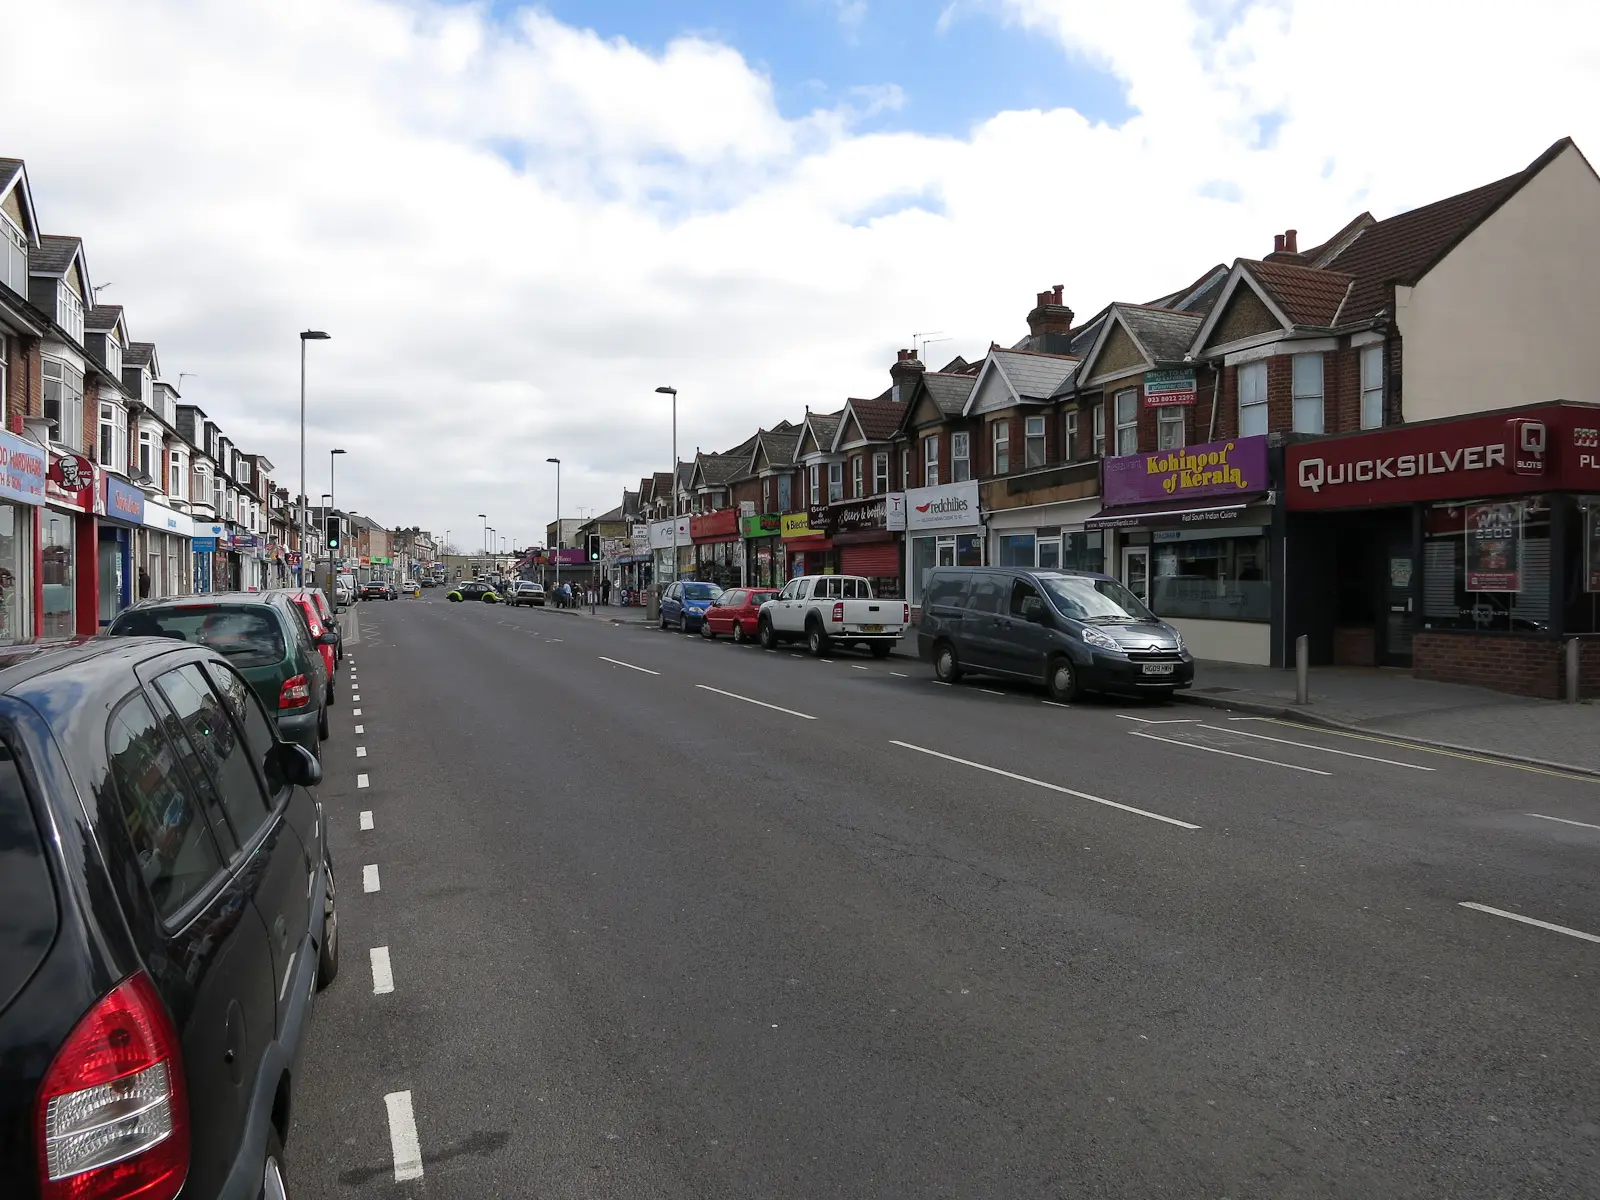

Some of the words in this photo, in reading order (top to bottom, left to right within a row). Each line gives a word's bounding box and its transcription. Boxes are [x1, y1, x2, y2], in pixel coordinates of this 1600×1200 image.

[1168, 369, 1178, 377] TO
[1147, 442, 1235, 474] Kohinoor
[1516, 460, 1542, 469] SLOTS
[1299, 443, 1505, 493] QUICKSILVER
[1162, 473, 1178, 493] of
[1180, 464, 1248, 489] Kerala
[811, 505, 829, 513] Beers
[844, 508, 860, 522] Beers
[861, 507, 866, 520] &
[1191, 512, 1204, 521] South
[1205, 511, 1219, 520] Indian
[1219, 510, 1237, 519] Cuisine
[1476, 512, 1512, 528] WIN
[1475, 528, 1512, 539] £500
